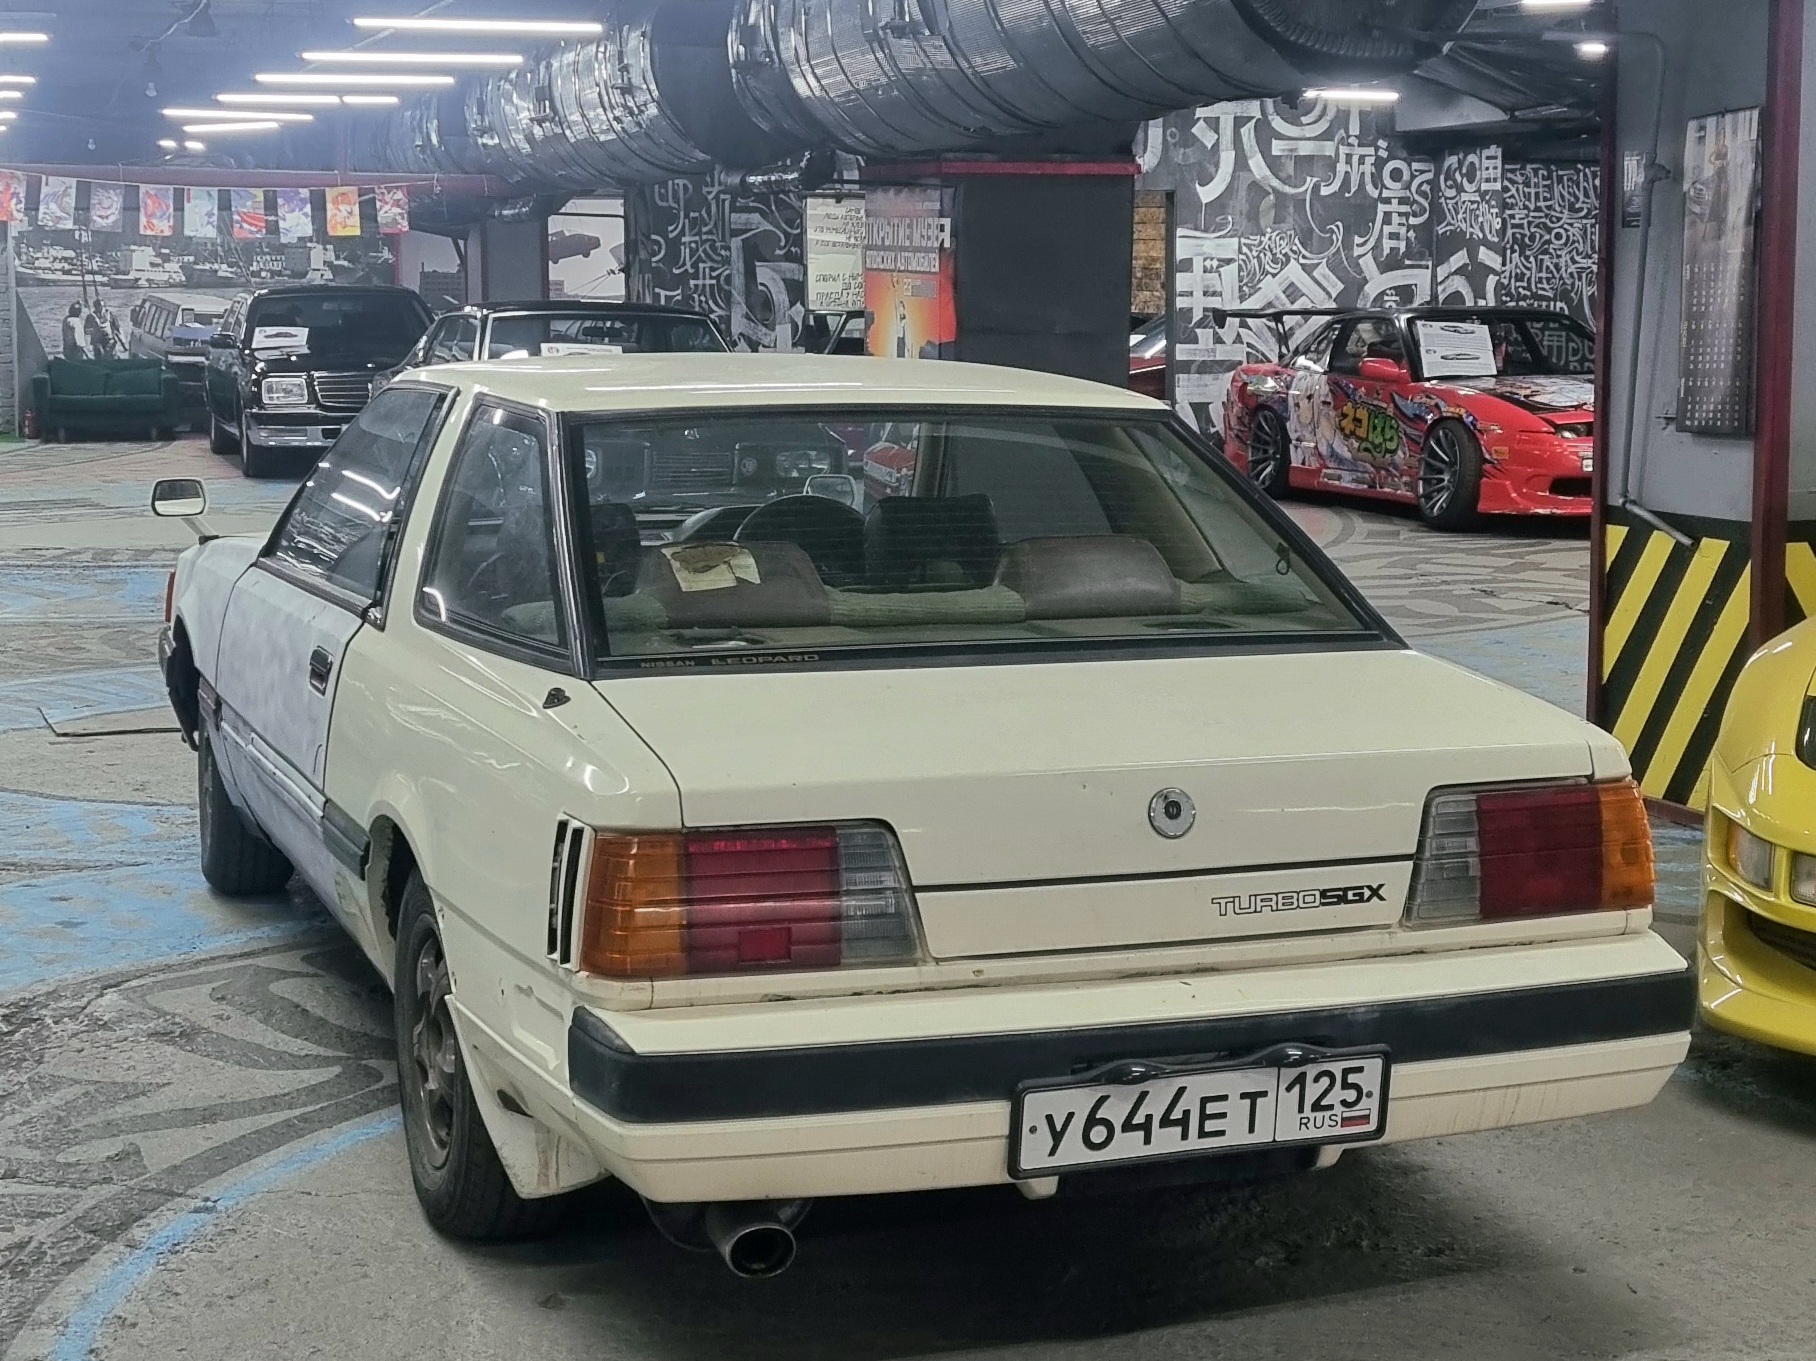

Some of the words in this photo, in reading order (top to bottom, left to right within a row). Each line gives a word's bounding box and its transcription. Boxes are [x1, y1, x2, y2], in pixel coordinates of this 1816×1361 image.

[912, 217, 951, 248] МУЗЕЯ
[640, 659, 697, 669] NISSAN
[711, 654, 820, 666] LEOPARD
[1044, 1085, 1269, 1158] У644ЕТ
[1285, 1066, 1366, 1115] 125
[1299, 1113, 1340, 1132] RUS
